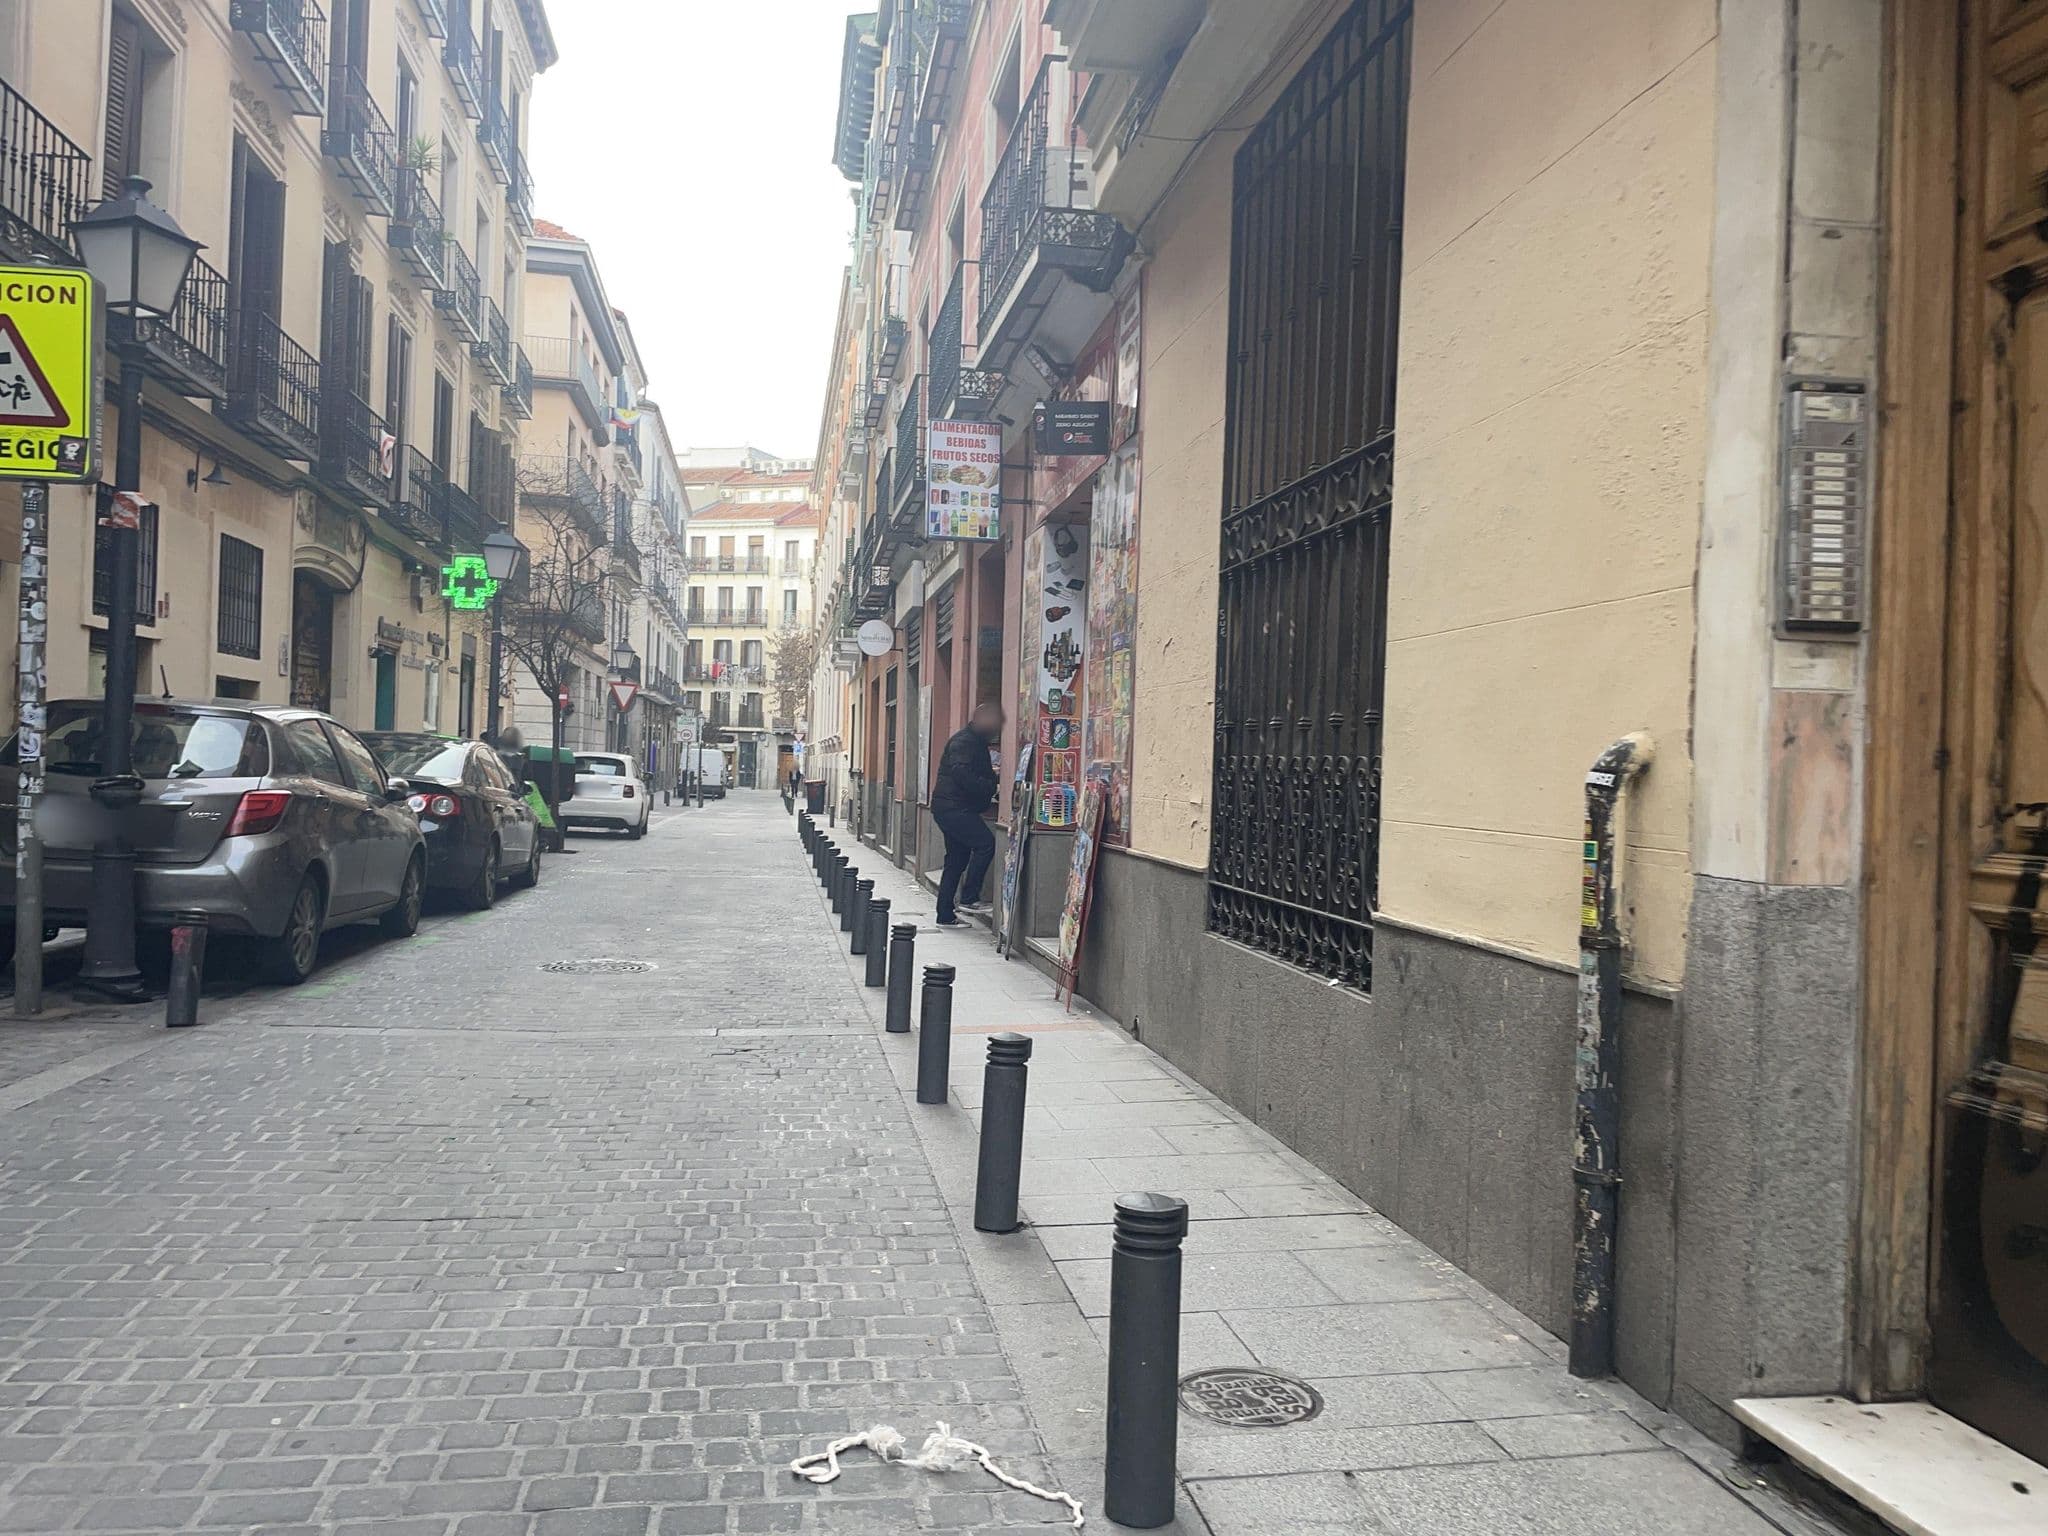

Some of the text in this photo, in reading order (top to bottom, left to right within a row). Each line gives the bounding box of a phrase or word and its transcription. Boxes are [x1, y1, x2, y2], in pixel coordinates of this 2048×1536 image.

[0, 283, 76, 304] CION
[946, 436, 987, 449] BEBIDAS
[932, 449, 1000, 464] FRUTOS SECOS
[1051, 794, 1063, 820] PRIME
[1203, 1403, 1281, 1420] Natural
